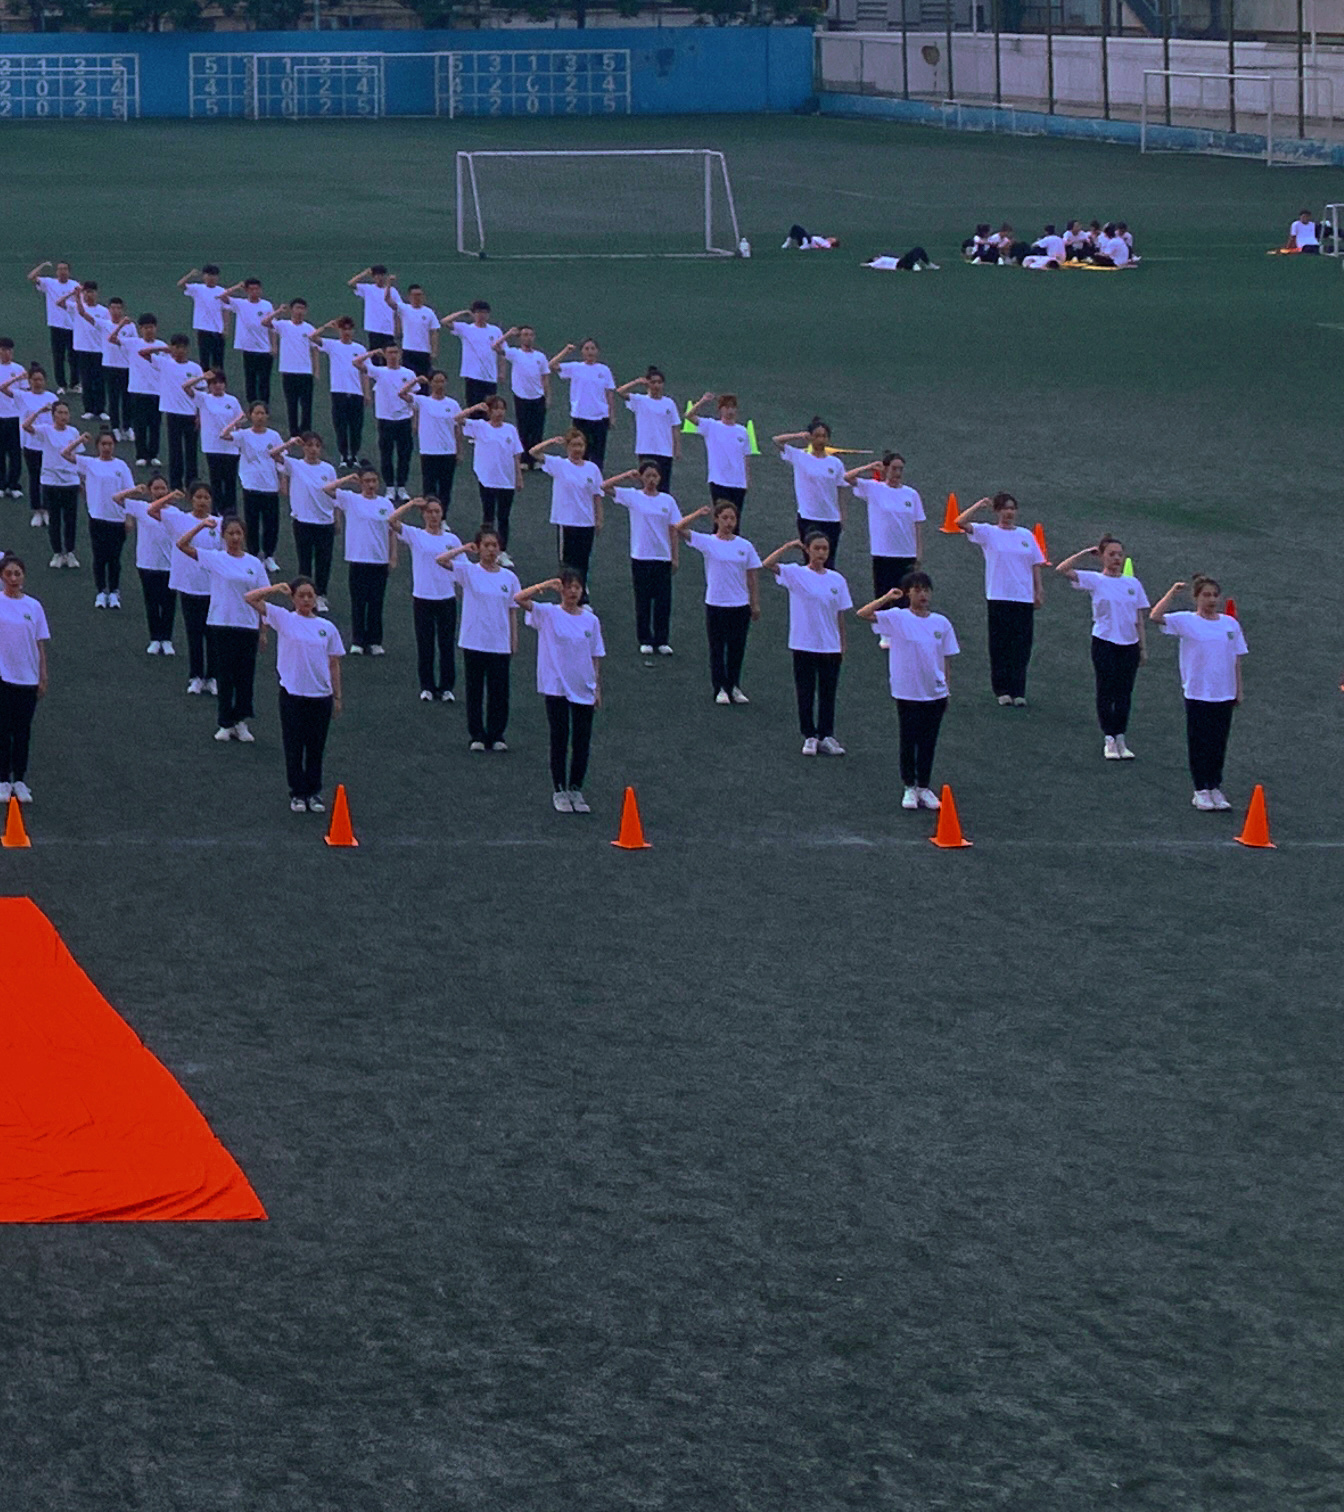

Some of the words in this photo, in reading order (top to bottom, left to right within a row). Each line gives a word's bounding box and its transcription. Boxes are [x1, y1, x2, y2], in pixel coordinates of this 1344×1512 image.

[205, 57, 217, 74] 5
[282, 57, 291, 73] 1
[452, 56, 463, 72] 5
[489, 55, 501, 71] 3
[529, 55, 537, 71] 1
[565, 55, 577, 71] 3
[603, 54, 615, 70] 5
[0, 80, 11, 96] 2
[36, 80, 48, 96] 0
[74, 80, 86, 96] 2
[205, 78, 217, 95] 4
[281, 78, 292, 94] 0
[319, 78, 331, 94] 2
[357, 78, 370, 93] 4
[489, 76, 501, 92] 2
[565, 76, 577, 91] 2
[603, 76, 615, 91] 4
[0, 101, 11, 117] 2
[36, 100, 48, 117] 0
[74, 100, 86, 116] 2
[205, 99, 217, 116] 5
[281, 98, 292, 115] 0
[319, 98, 331, 114] 2
[357, 98, 370, 114] 5
[489, 97, 501, 114] 2
[526, 97, 539, 113] 0
[565, 97, 577, 113] 2
[603, 97, 615, 112] 5
